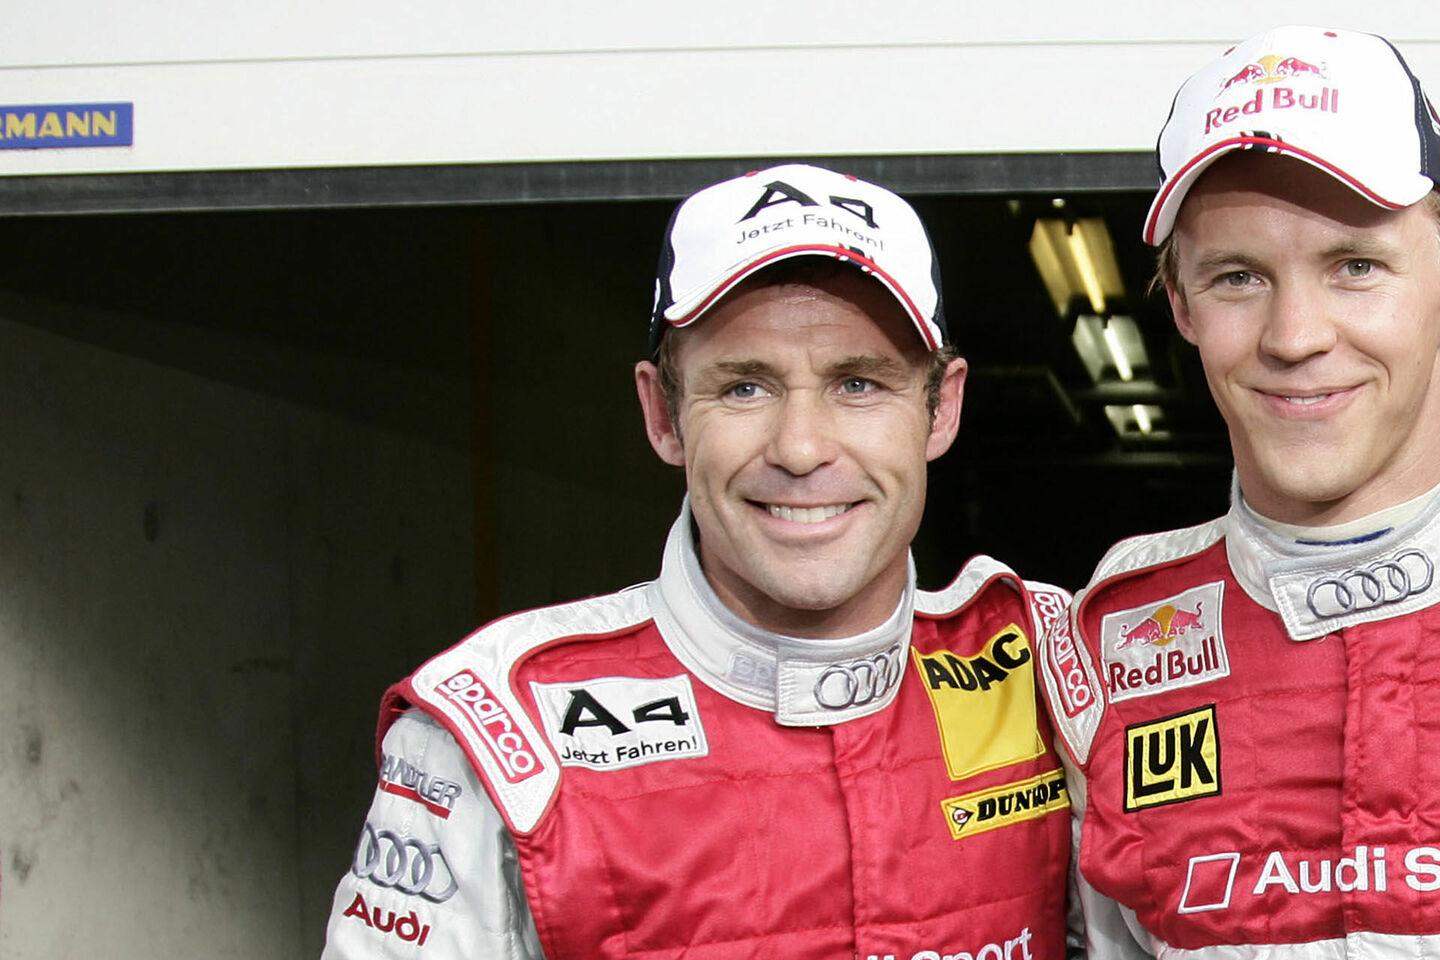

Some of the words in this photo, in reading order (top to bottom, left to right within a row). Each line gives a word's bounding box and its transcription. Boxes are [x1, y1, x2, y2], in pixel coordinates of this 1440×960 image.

[1204, 89, 1263, 134] Red
[1273, 87, 1339, 114] Bull
[735, 180, 880, 230] A4
[736, 217, 794, 245] Jetzt
[803, 213, 884, 252] Fahren!
[922, 632, 1031, 692] ADAC
[1109, 652, 1163, 693] Red
[1167, 635, 1220, 681] Bull
[441, 672, 536, 777] sparco
[559, 688, 690, 736] A4
[561, 746, 610, 764] Jetzt
[617, 735, 698, 763] Fahren!
[1252, 845, 1388, 895] Audi
[343, 891, 431, 946] Audi
